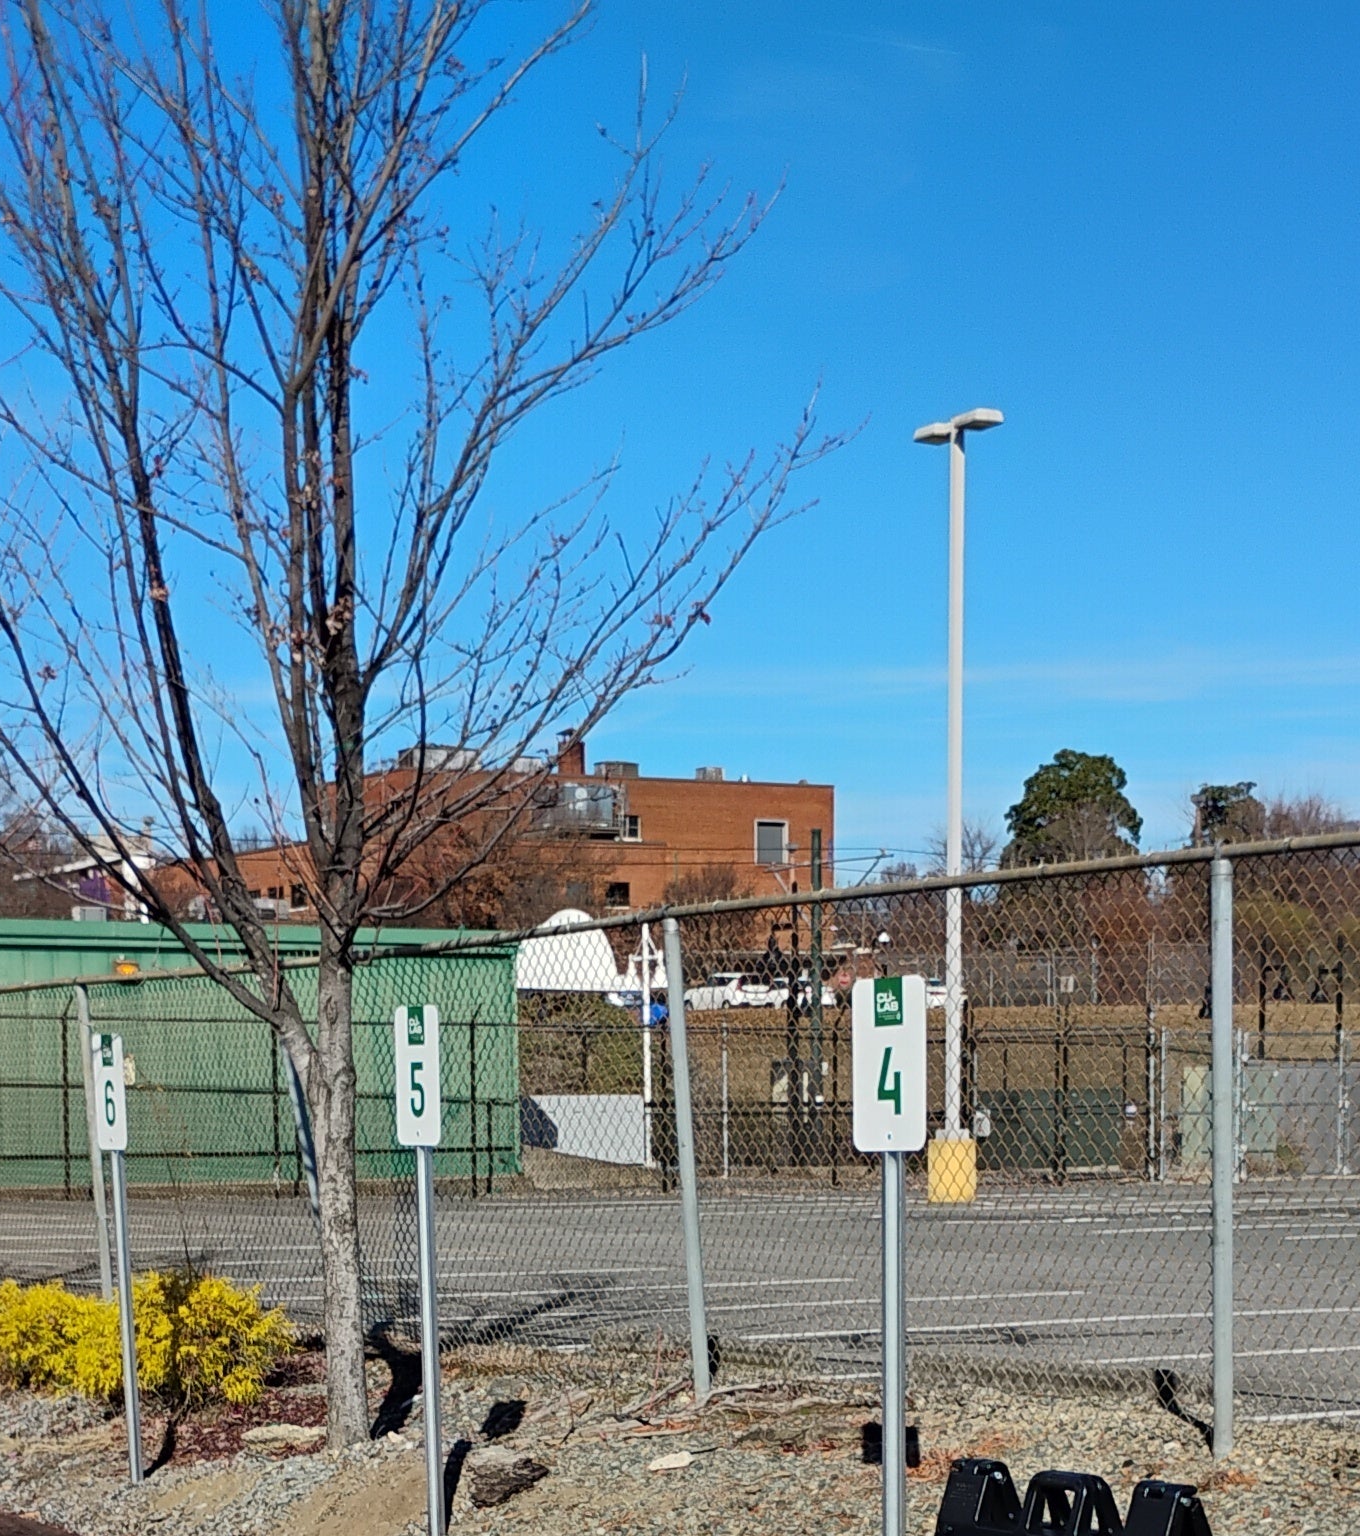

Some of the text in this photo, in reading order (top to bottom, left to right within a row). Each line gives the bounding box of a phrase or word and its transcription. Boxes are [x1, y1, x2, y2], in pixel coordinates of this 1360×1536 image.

[877, 1001, 898, 1012] LAB
[105, 1080, 115, 1126] 6
[411, 1062, 425, 1118] 5
[877, 1047, 901, 1115] 4
